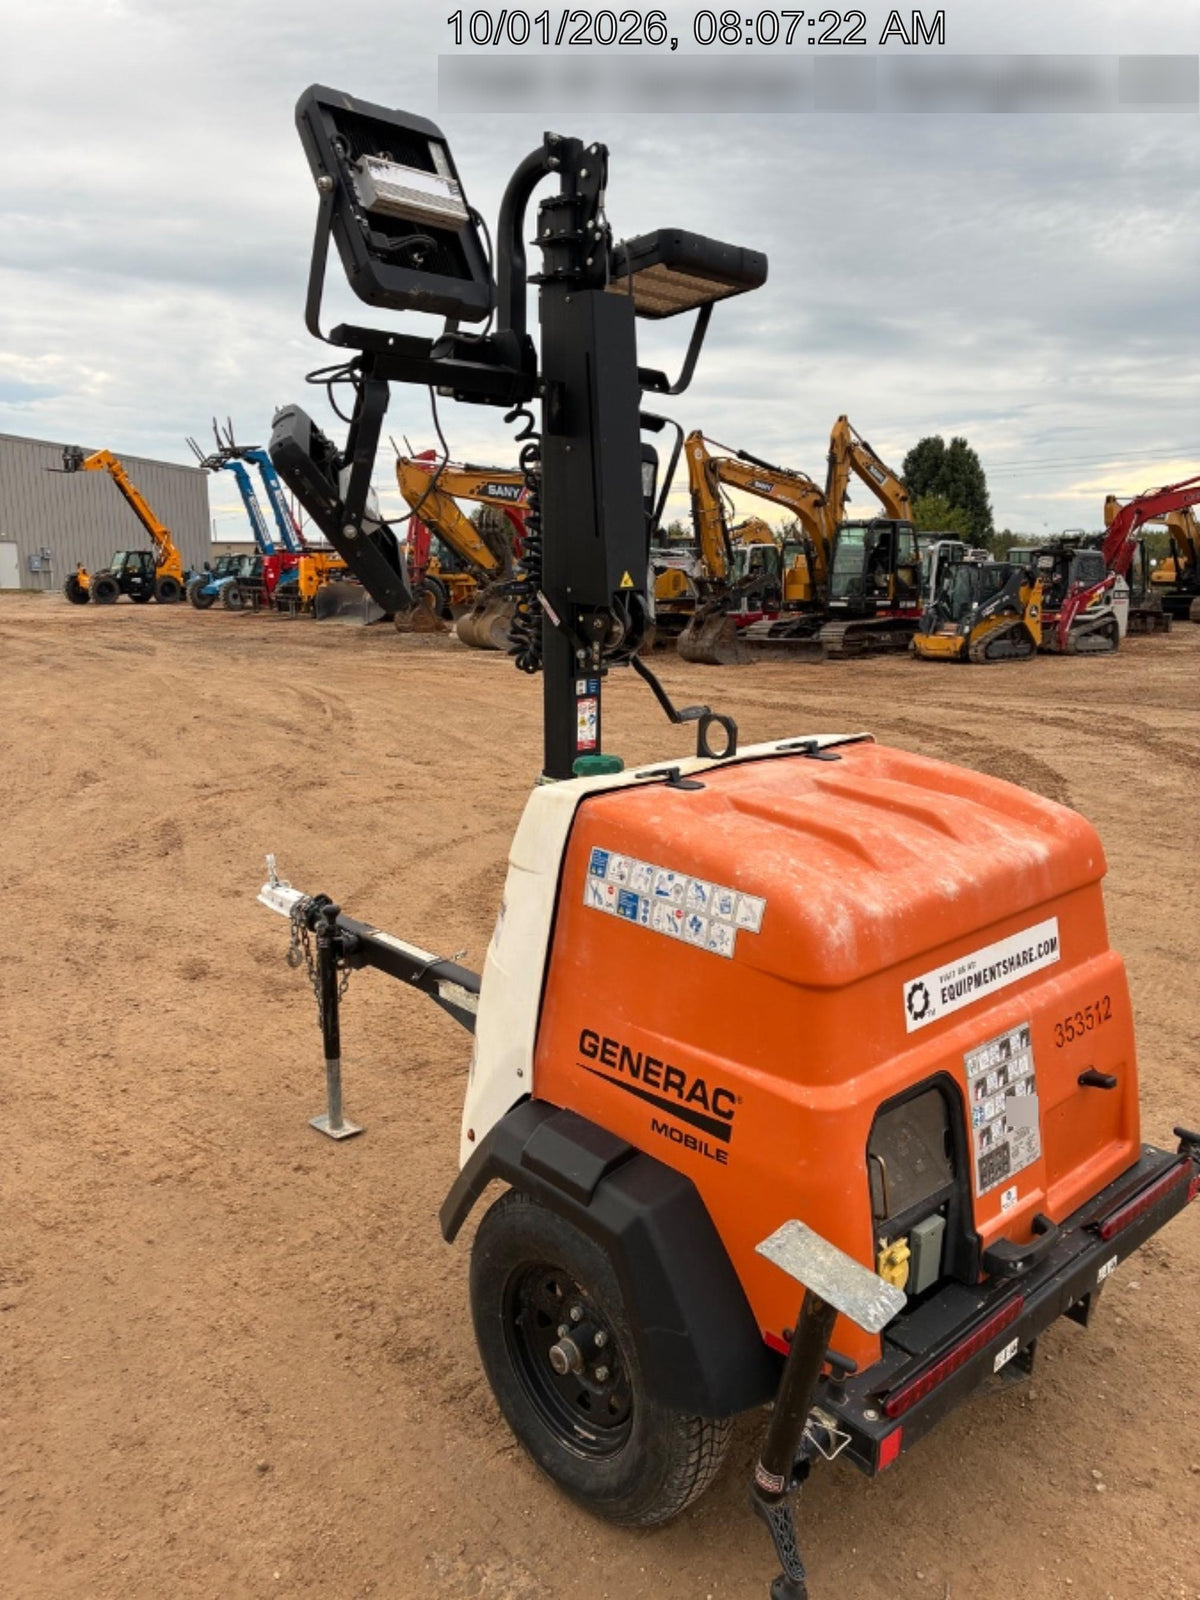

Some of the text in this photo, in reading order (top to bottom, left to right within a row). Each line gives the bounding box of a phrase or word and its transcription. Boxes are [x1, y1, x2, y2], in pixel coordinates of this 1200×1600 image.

[488, 484, 520, 498] SANY
[941, 937, 1058, 1004] EQUIPMENTSHARE.COM
[1054, 994, 1112, 1048] 353512
[578, 1028, 736, 1121] GENERAC
[651, 1118, 728, 1165] MOBILE
